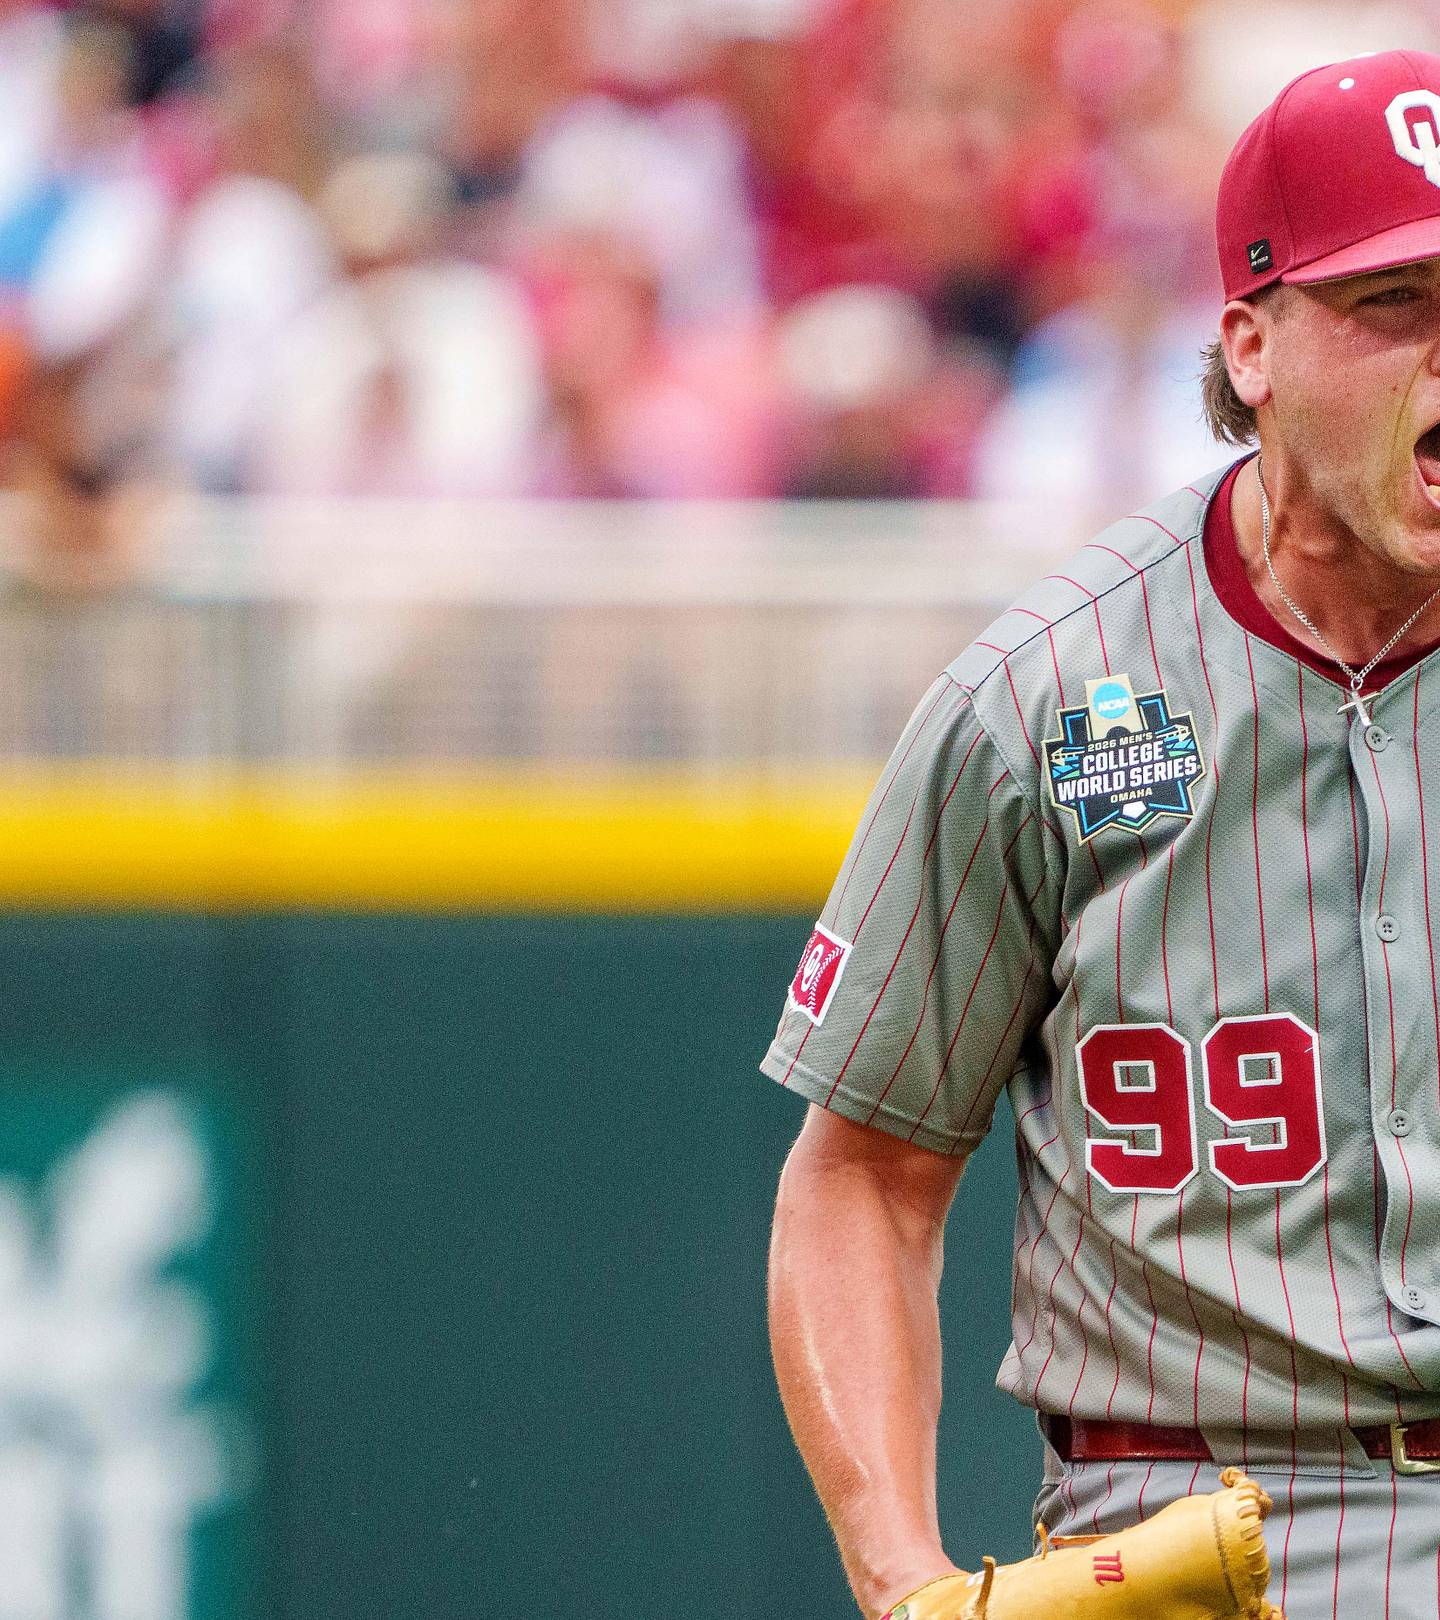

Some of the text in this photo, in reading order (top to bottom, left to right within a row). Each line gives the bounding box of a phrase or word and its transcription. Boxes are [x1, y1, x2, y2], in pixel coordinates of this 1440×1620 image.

[1097, 697, 1129, 712] NCAA
[1087, 732, 1154, 752] 2026 MEN'S
[1083, 740, 1165, 776] COLLEGE
[1057, 755, 1198, 803] WORLD SERIES
[1110, 787, 1154, 804] OMAHA
[1075, 1011, 1329, 1195] 99
